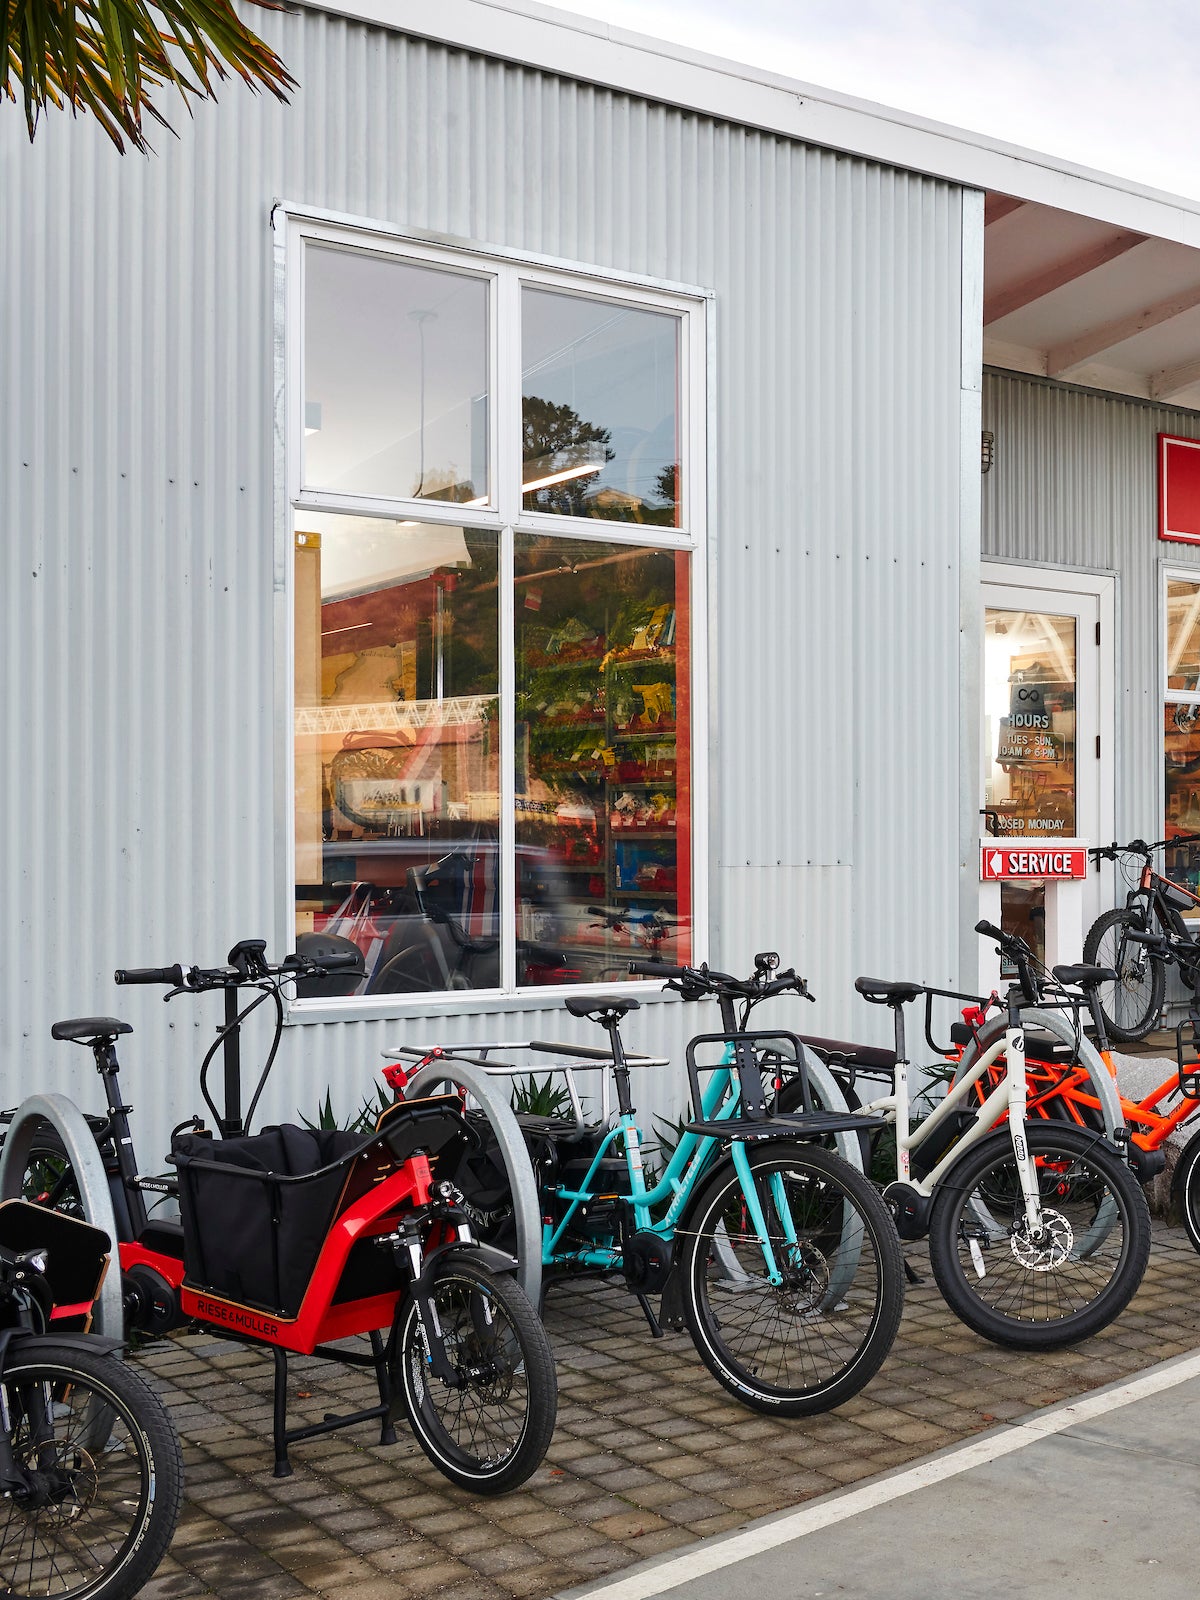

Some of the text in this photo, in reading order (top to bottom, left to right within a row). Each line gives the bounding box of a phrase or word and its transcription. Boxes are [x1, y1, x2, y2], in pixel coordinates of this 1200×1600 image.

[1008, 714, 1050, 729] HOURS
[1007, 734, 1028, 745] TUES
[1028, 818, 1065, 830] MONDAY
[1008, 852, 1072, 874] SERVICE
